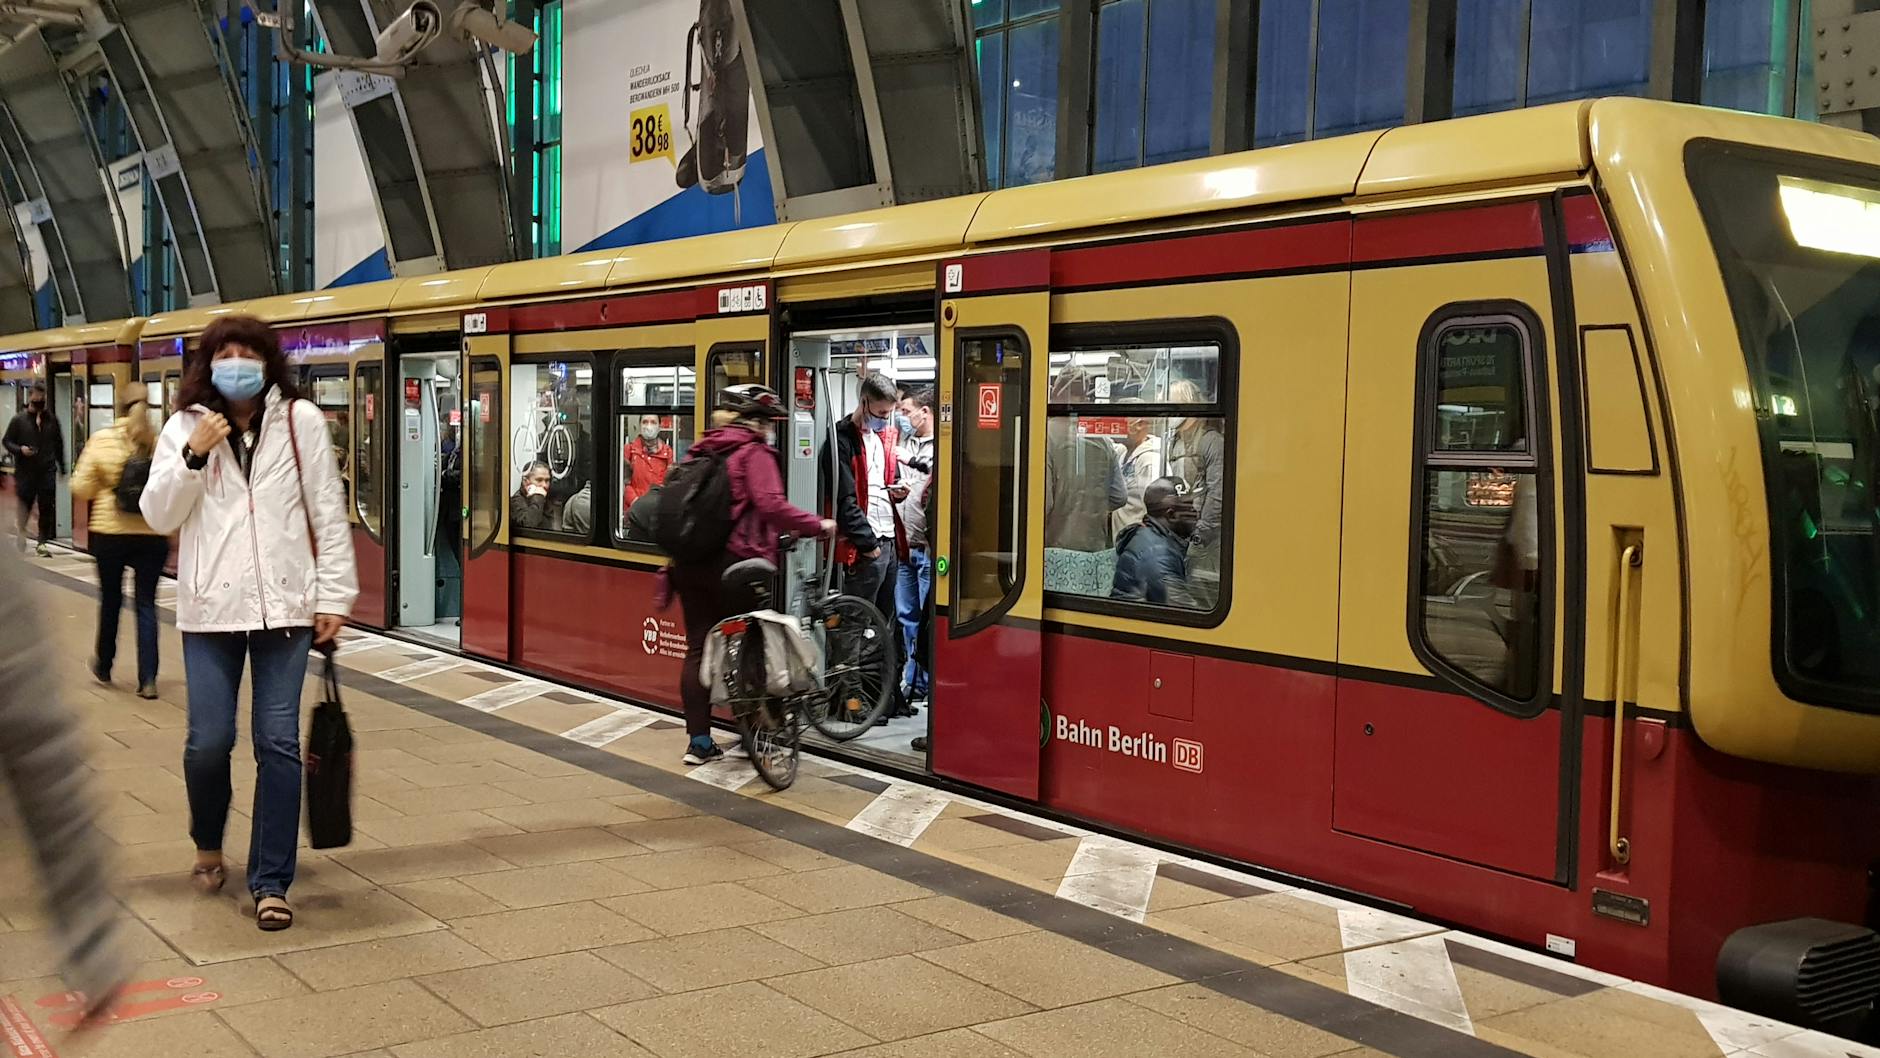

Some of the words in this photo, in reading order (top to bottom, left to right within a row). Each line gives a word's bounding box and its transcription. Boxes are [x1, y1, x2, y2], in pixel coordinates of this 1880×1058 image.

[632, 115, 656, 157] 38
[644, 629, 657, 642] VBB
[1056, 714, 1102, 748] Bahn
[1108, 725, 1167, 763] Berlin
[1176, 742, 1200, 769] DB
